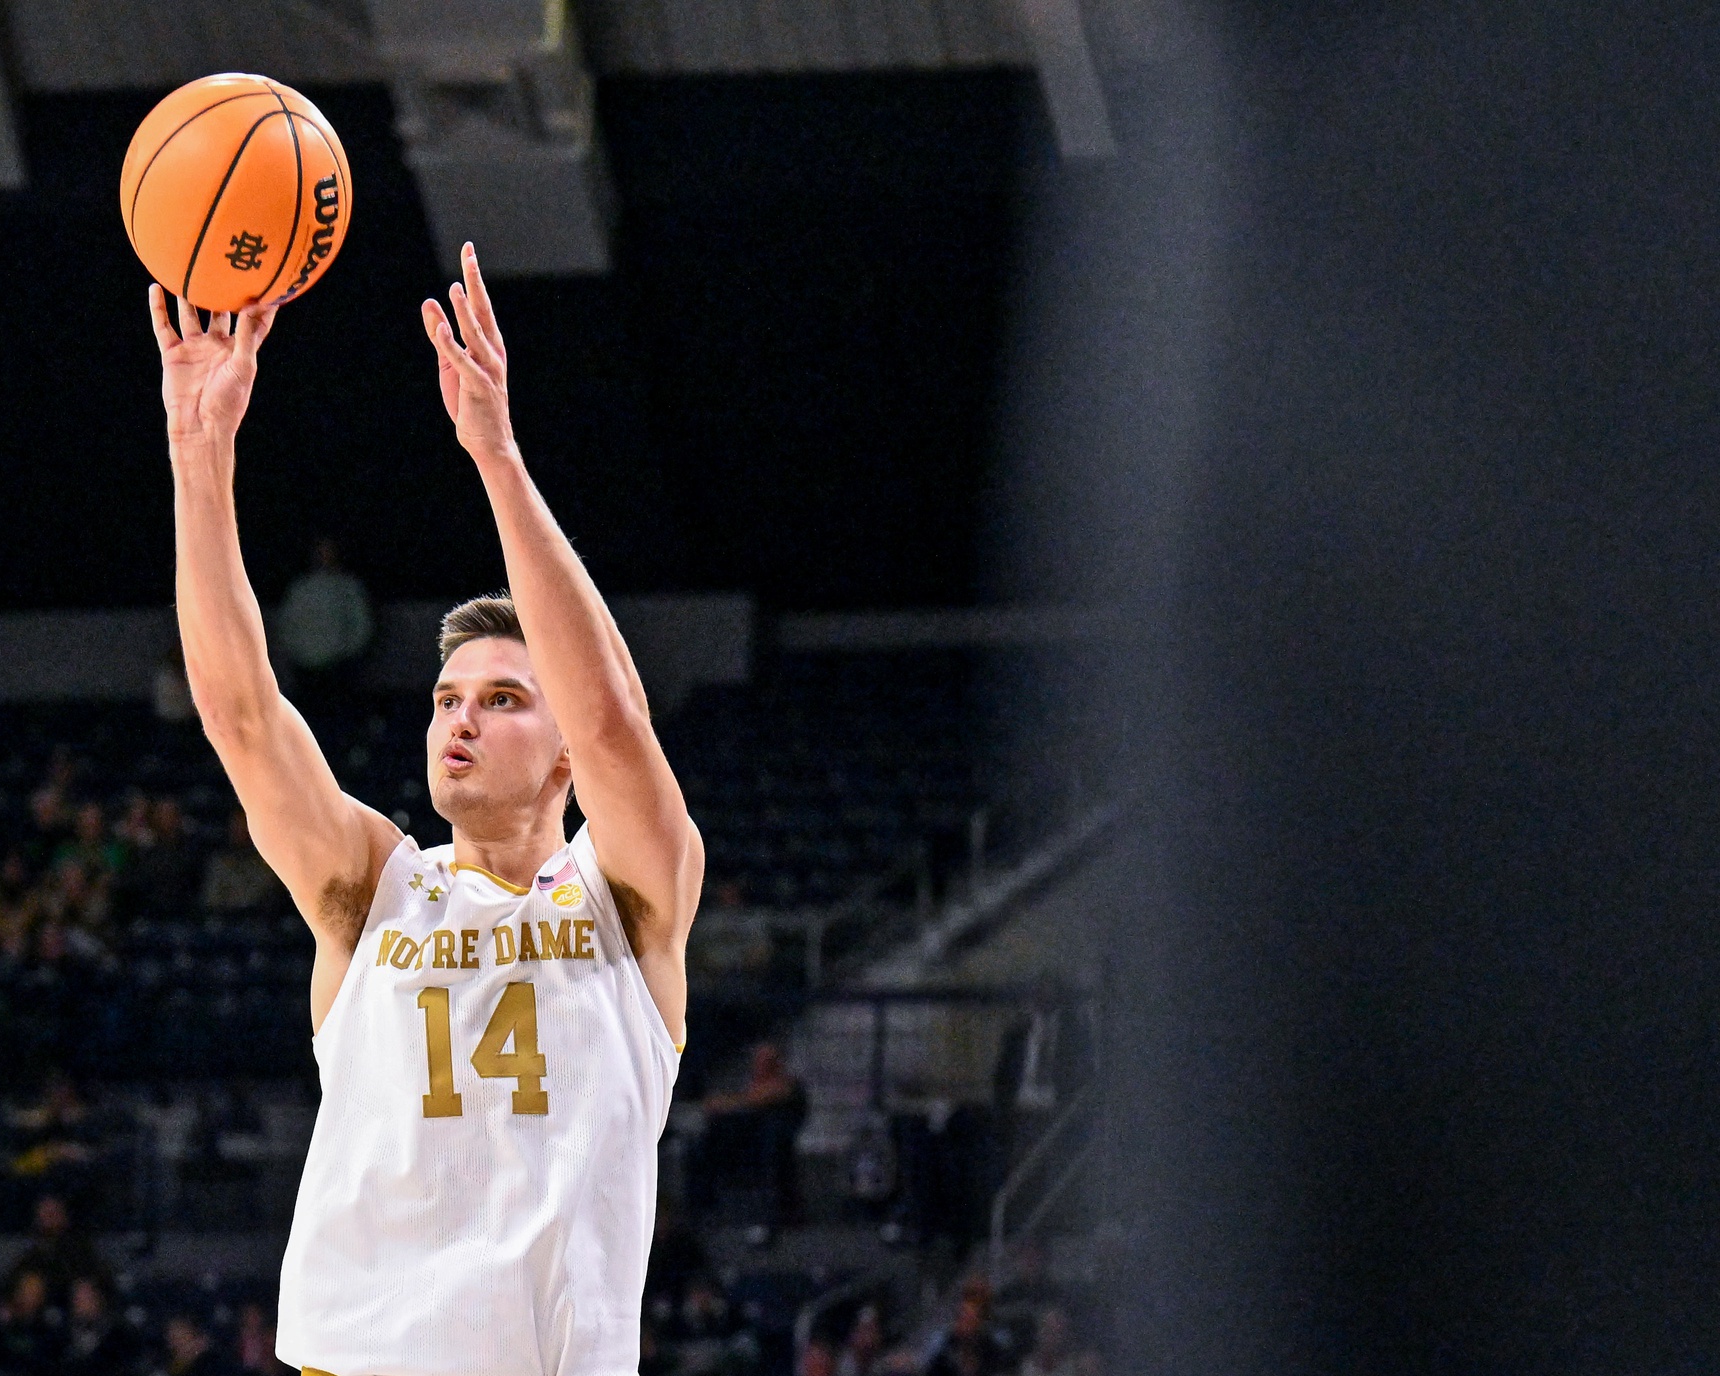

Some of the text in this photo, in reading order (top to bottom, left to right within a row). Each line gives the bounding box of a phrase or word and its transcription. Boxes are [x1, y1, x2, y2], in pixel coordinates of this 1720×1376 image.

[555, 886, 581, 903] ACC
[376, 919, 595, 971] NOTRE DAME
[417, 982, 549, 1118] 14
